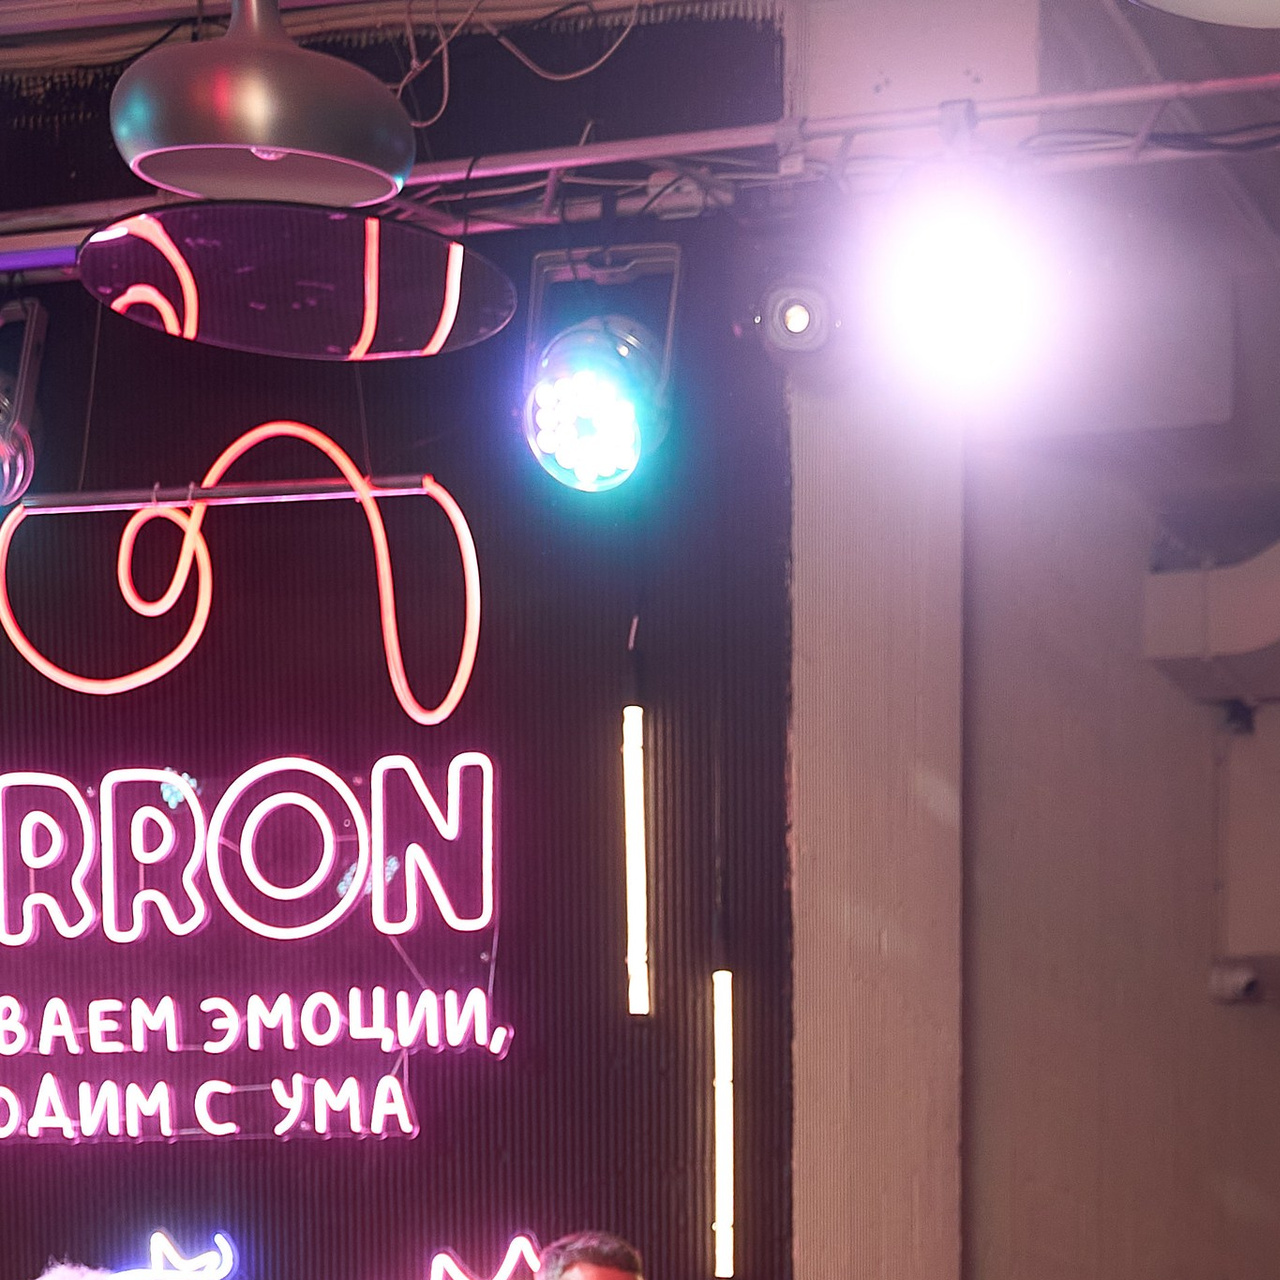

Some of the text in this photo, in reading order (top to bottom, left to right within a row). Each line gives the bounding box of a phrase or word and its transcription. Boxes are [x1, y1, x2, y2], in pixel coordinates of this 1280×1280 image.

[0, 985, 512, 1056] ВАЕМ ЭМОЦИИ,
[194, 1080, 238, 1136] С
[272, 1073, 415, 1137] УМА
